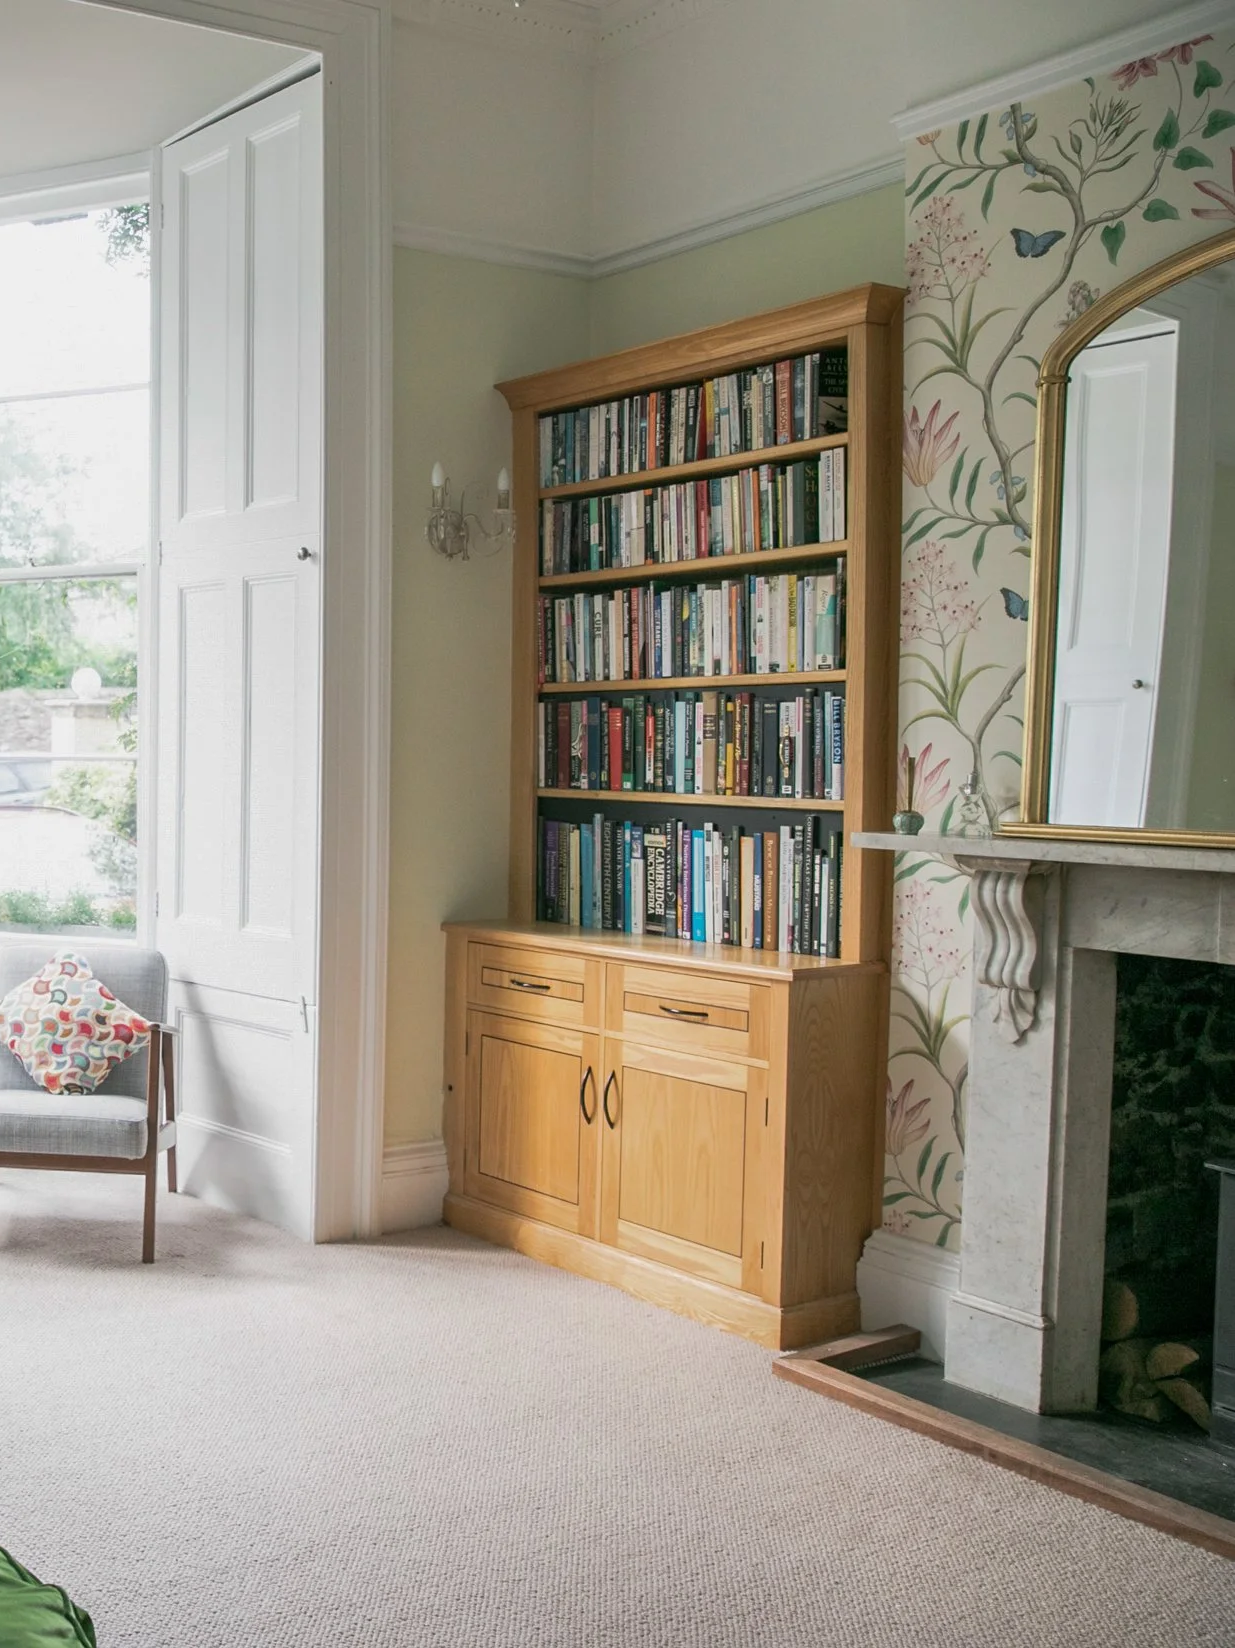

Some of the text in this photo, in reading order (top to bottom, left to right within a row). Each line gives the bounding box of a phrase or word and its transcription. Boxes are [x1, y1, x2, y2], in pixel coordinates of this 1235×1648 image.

[594, 611, 602, 639] CURE
[833, 700, 841, 763] BILL BRYSON
[603, 822, 612, 919] EIGHTEENTH CENTURY
[647, 847, 655, 915] ENCYCLOPEDIA
[655, 848, 665, 916] CAMBRIDGE
